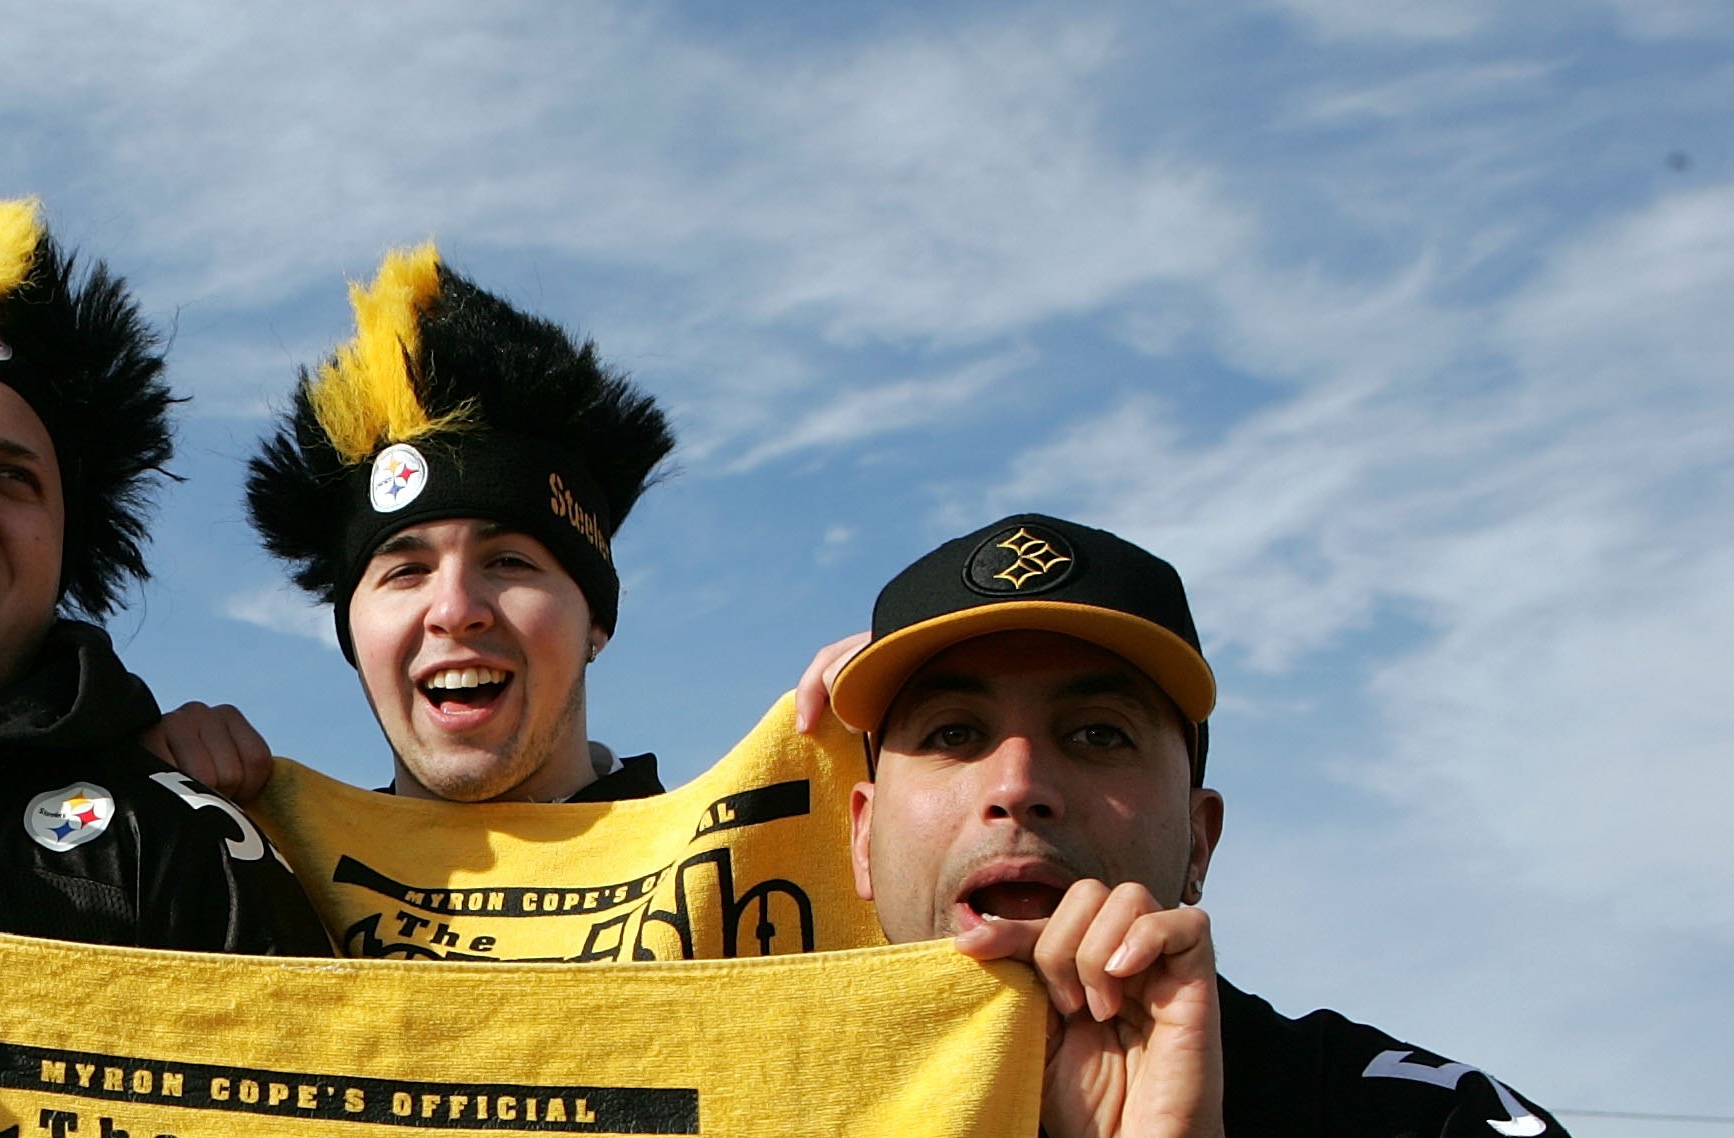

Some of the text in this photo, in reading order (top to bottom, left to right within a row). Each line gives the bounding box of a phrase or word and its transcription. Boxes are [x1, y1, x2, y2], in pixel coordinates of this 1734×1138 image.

[148, 771, 294, 874] 5
[404, 883, 627, 912] MYRON COPE'S
[395, 909, 497, 953] The
[40, 1059, 597, 1124] MYRON COPE'S OFFICIAL
